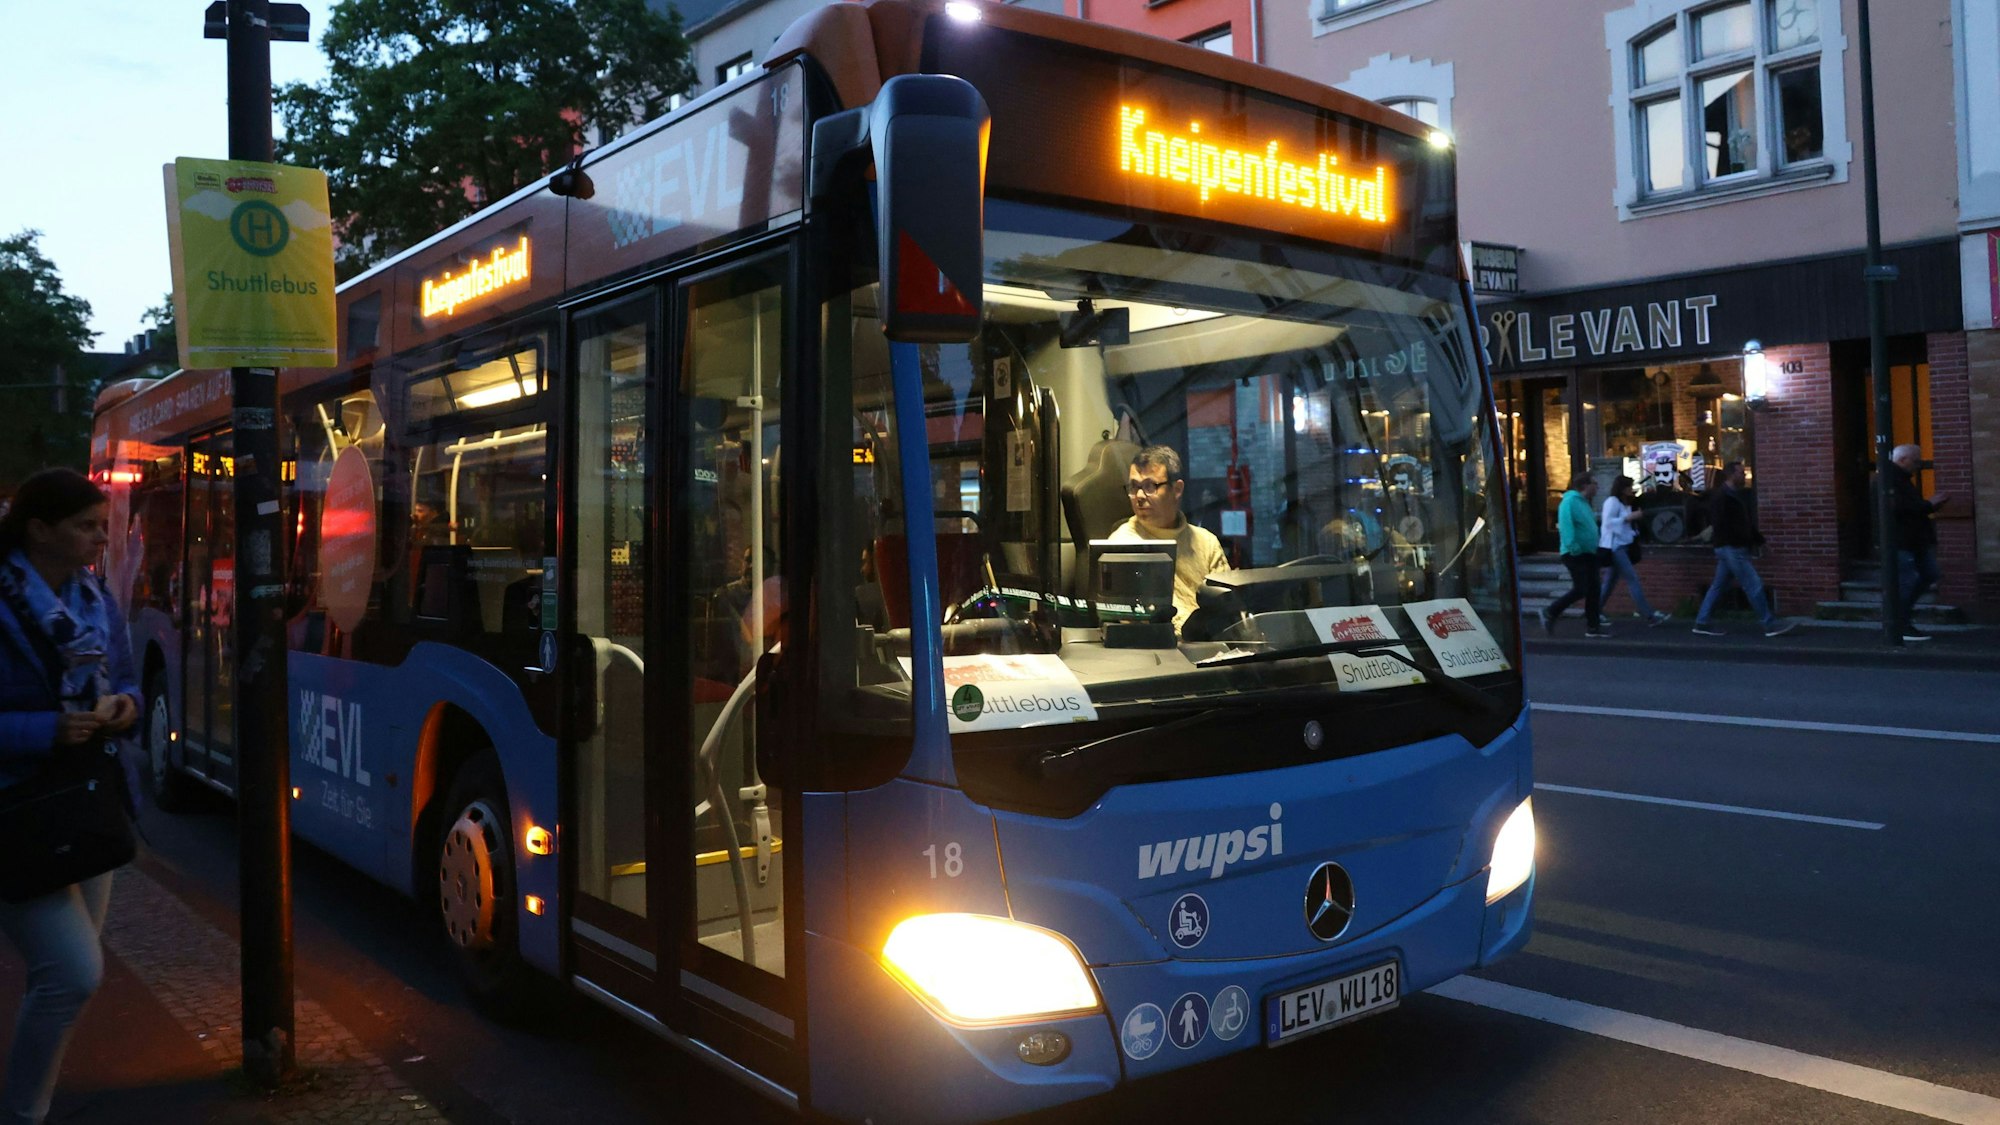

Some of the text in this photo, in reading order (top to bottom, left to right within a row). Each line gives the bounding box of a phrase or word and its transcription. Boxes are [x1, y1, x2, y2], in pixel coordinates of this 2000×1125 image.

[771, 83, 789, 116] 18
[653, 119, 744, 236] EVL
[1120, 104, 1387, 222] Kneipenfestival
[207, 270, 318, 295] Shuttlebus
[422, 236, 528, 317] Kneipenfestival
[1518, 295, 1717, 362] LEVANT
[1780, 361, 1804, 375] 103
[1348, 624, 1378, 634] KNEIPEN
[1352, 632, 1387, 640] FESTIVAL
[1342, 656, 1415, 684] Shuttlebus
[1441, 646, 1500, 668] Shuttlebus
[946, 687, 1081, 715] uttlebus
[321, 694, 372, 787] EVL
[321, 779, 339, 813] Zeit
[1137, 802, 1284, 880] wupsi
[922, 842, 964, 880] 18
[1280, 988, 1325, 1033] LEV
